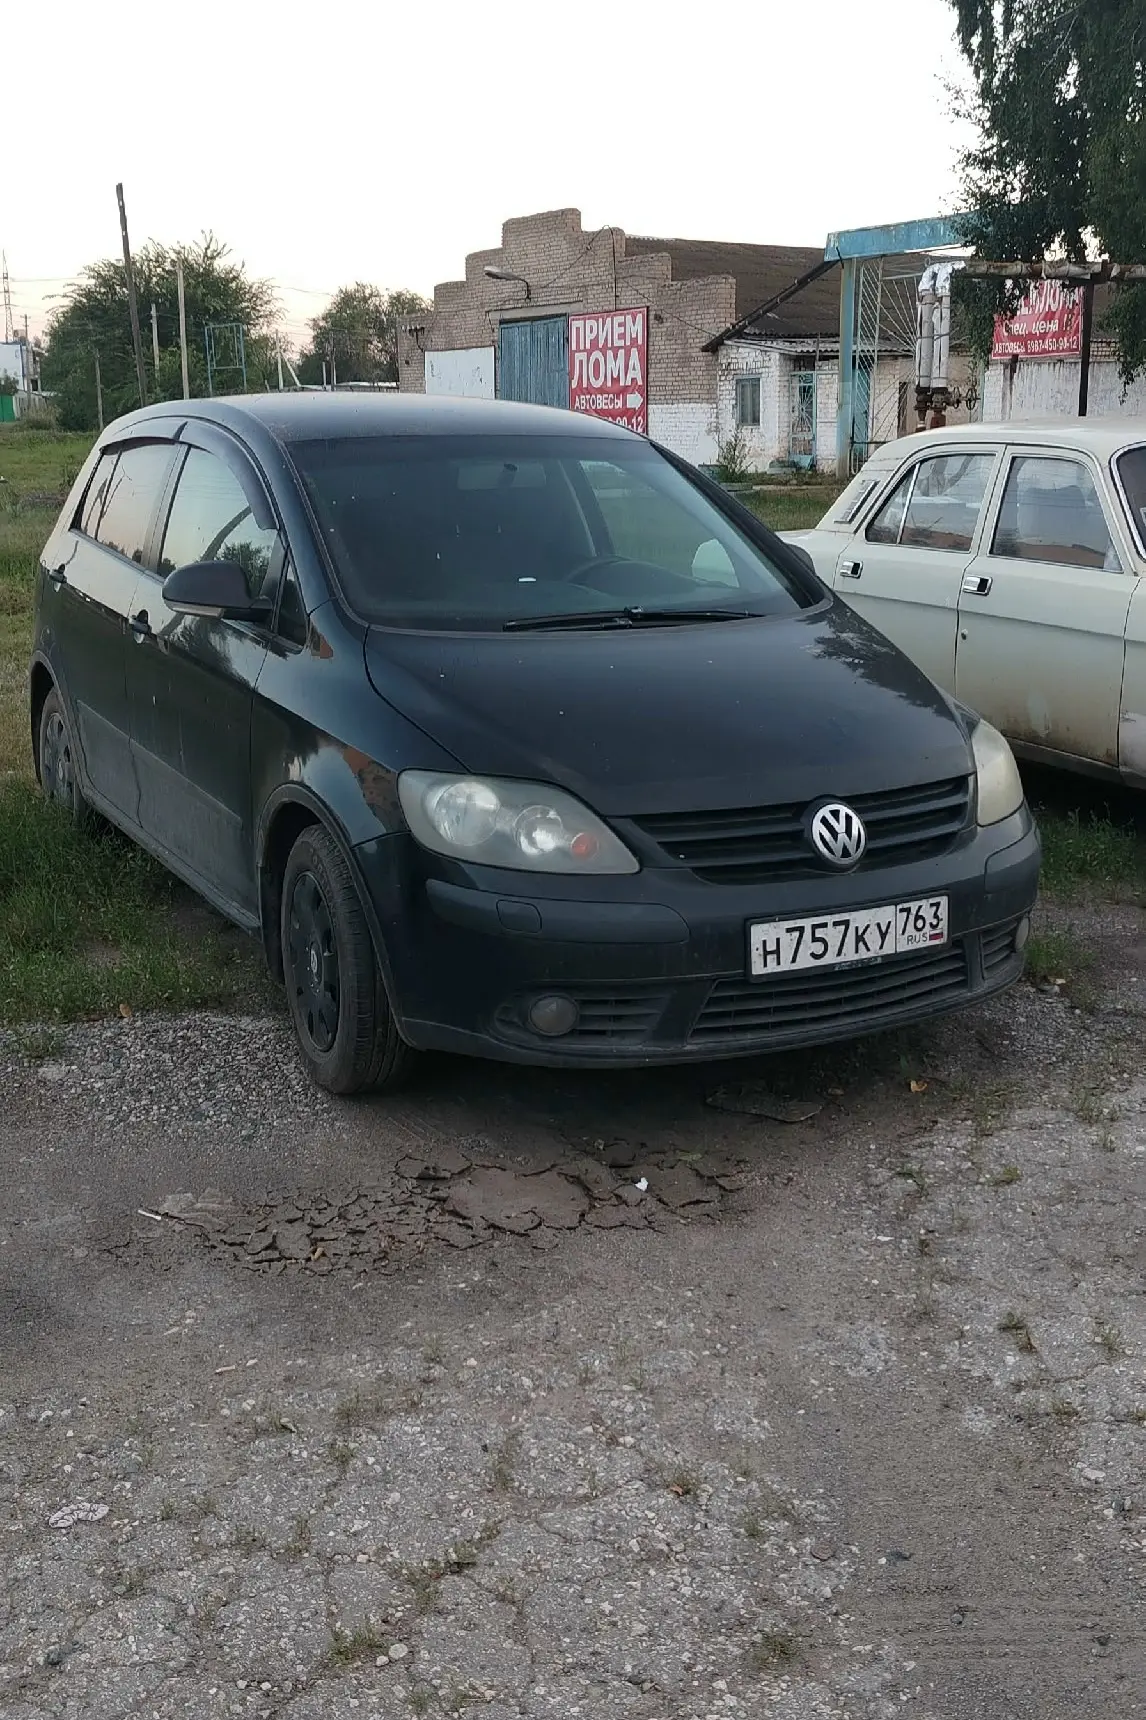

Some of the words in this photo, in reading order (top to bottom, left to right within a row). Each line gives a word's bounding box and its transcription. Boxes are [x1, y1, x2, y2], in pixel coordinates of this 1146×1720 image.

[571, 313, 643, 351] ПРИЕМ
[1032, 319, 1059, 337] цена
[994, 341, 1026, 354] АВТОВЕСЫ
[571, 347, 643, 390] ЛОМА
[574, 393, 623, 410] АВТОВЕСЫ
[761, 919, 892, 968] Н757КУ
[899, 901, 943, 936] 763
[906, 935, 928, 945] RUS
